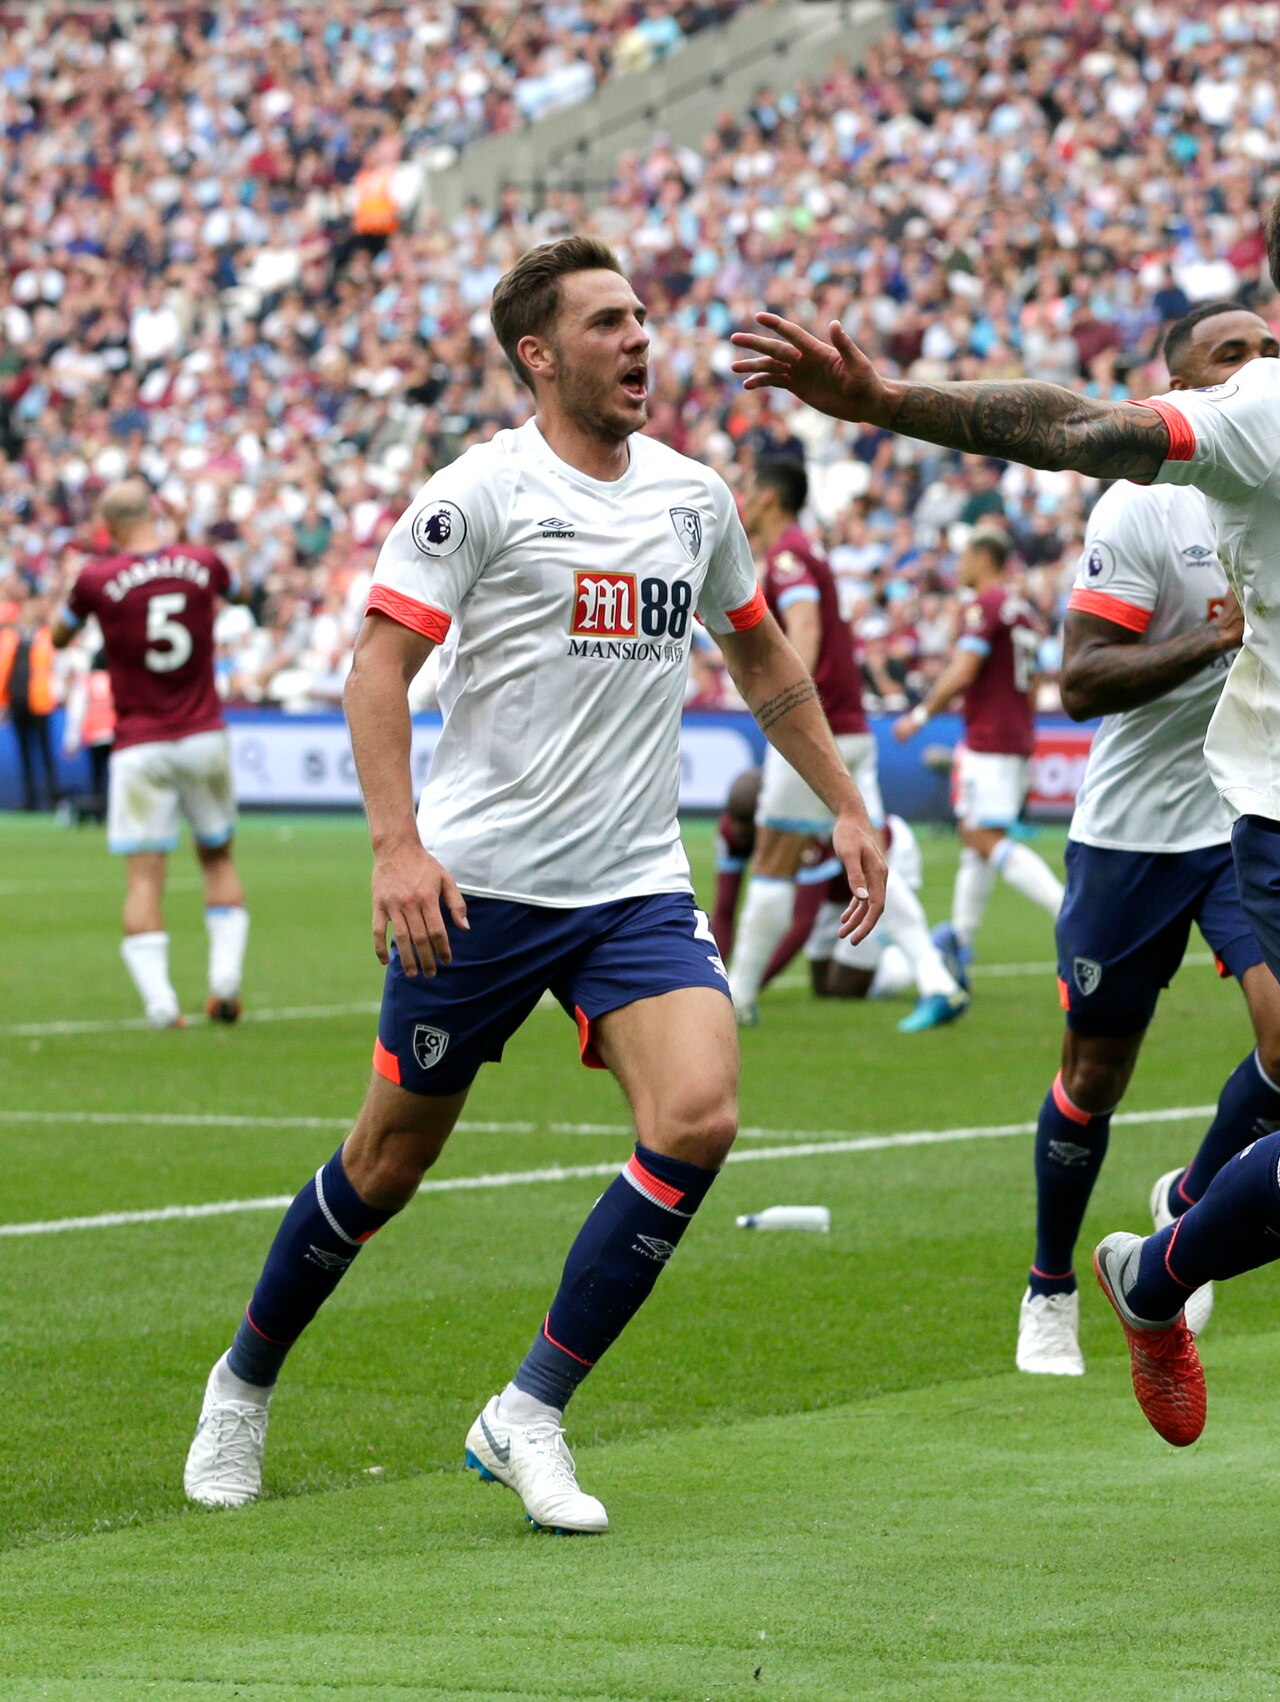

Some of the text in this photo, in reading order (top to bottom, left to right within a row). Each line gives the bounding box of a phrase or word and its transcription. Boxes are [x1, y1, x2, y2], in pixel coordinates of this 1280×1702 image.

[542, 530, 575, 539] umbro
[144, 592, 193, 673] 5
[567, 639, 663, 662] MANSION
